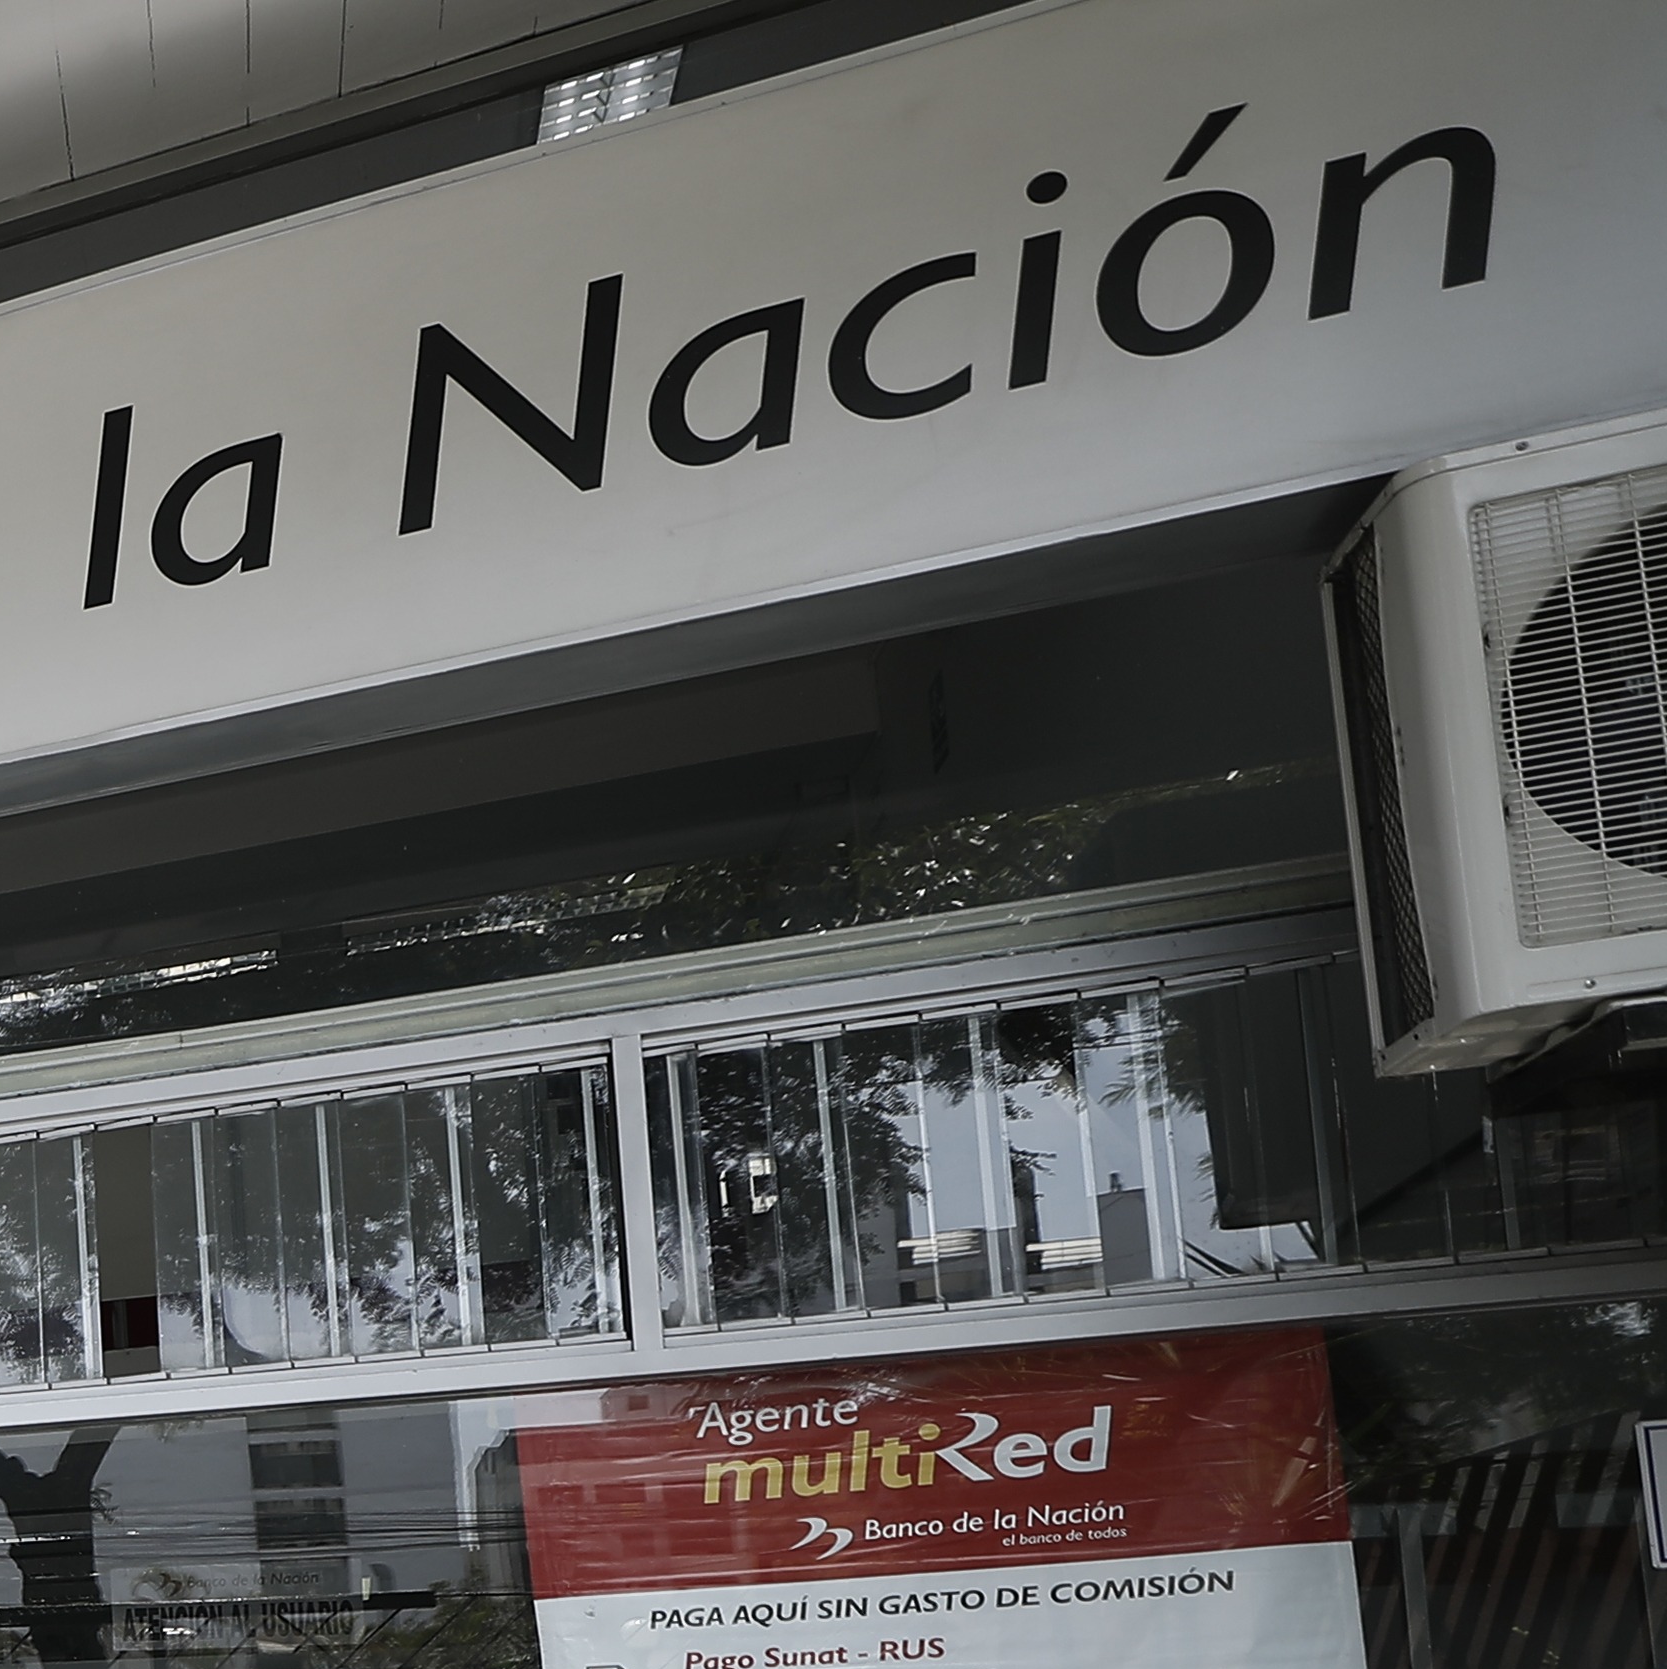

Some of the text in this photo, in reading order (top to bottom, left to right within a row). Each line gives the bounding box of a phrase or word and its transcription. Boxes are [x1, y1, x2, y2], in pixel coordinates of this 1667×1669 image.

[84, 406, 282, 609] la
[399, 127, 1496, 535] Nación
[697, 1398, 860, 1446] Agente
[703, 1405, 1113, 1505] multiRed
[865, 1500, 1125, 1540] Banco de la Nación
[1002, 1526, 1128, 1547] el banco de todos
[188, 1569, 320, 1588] Banco de la Nación
[650, 1569, 1235, 1630] PAGA AQUÍ SIN GASTO DE COMISIÓN
[123, 1595, 354, 1641] ATENCIÓN AL USUARIO
[764, 1646, 848, 1668] Sunat
[879, 1637, 945, 1662] RUS
